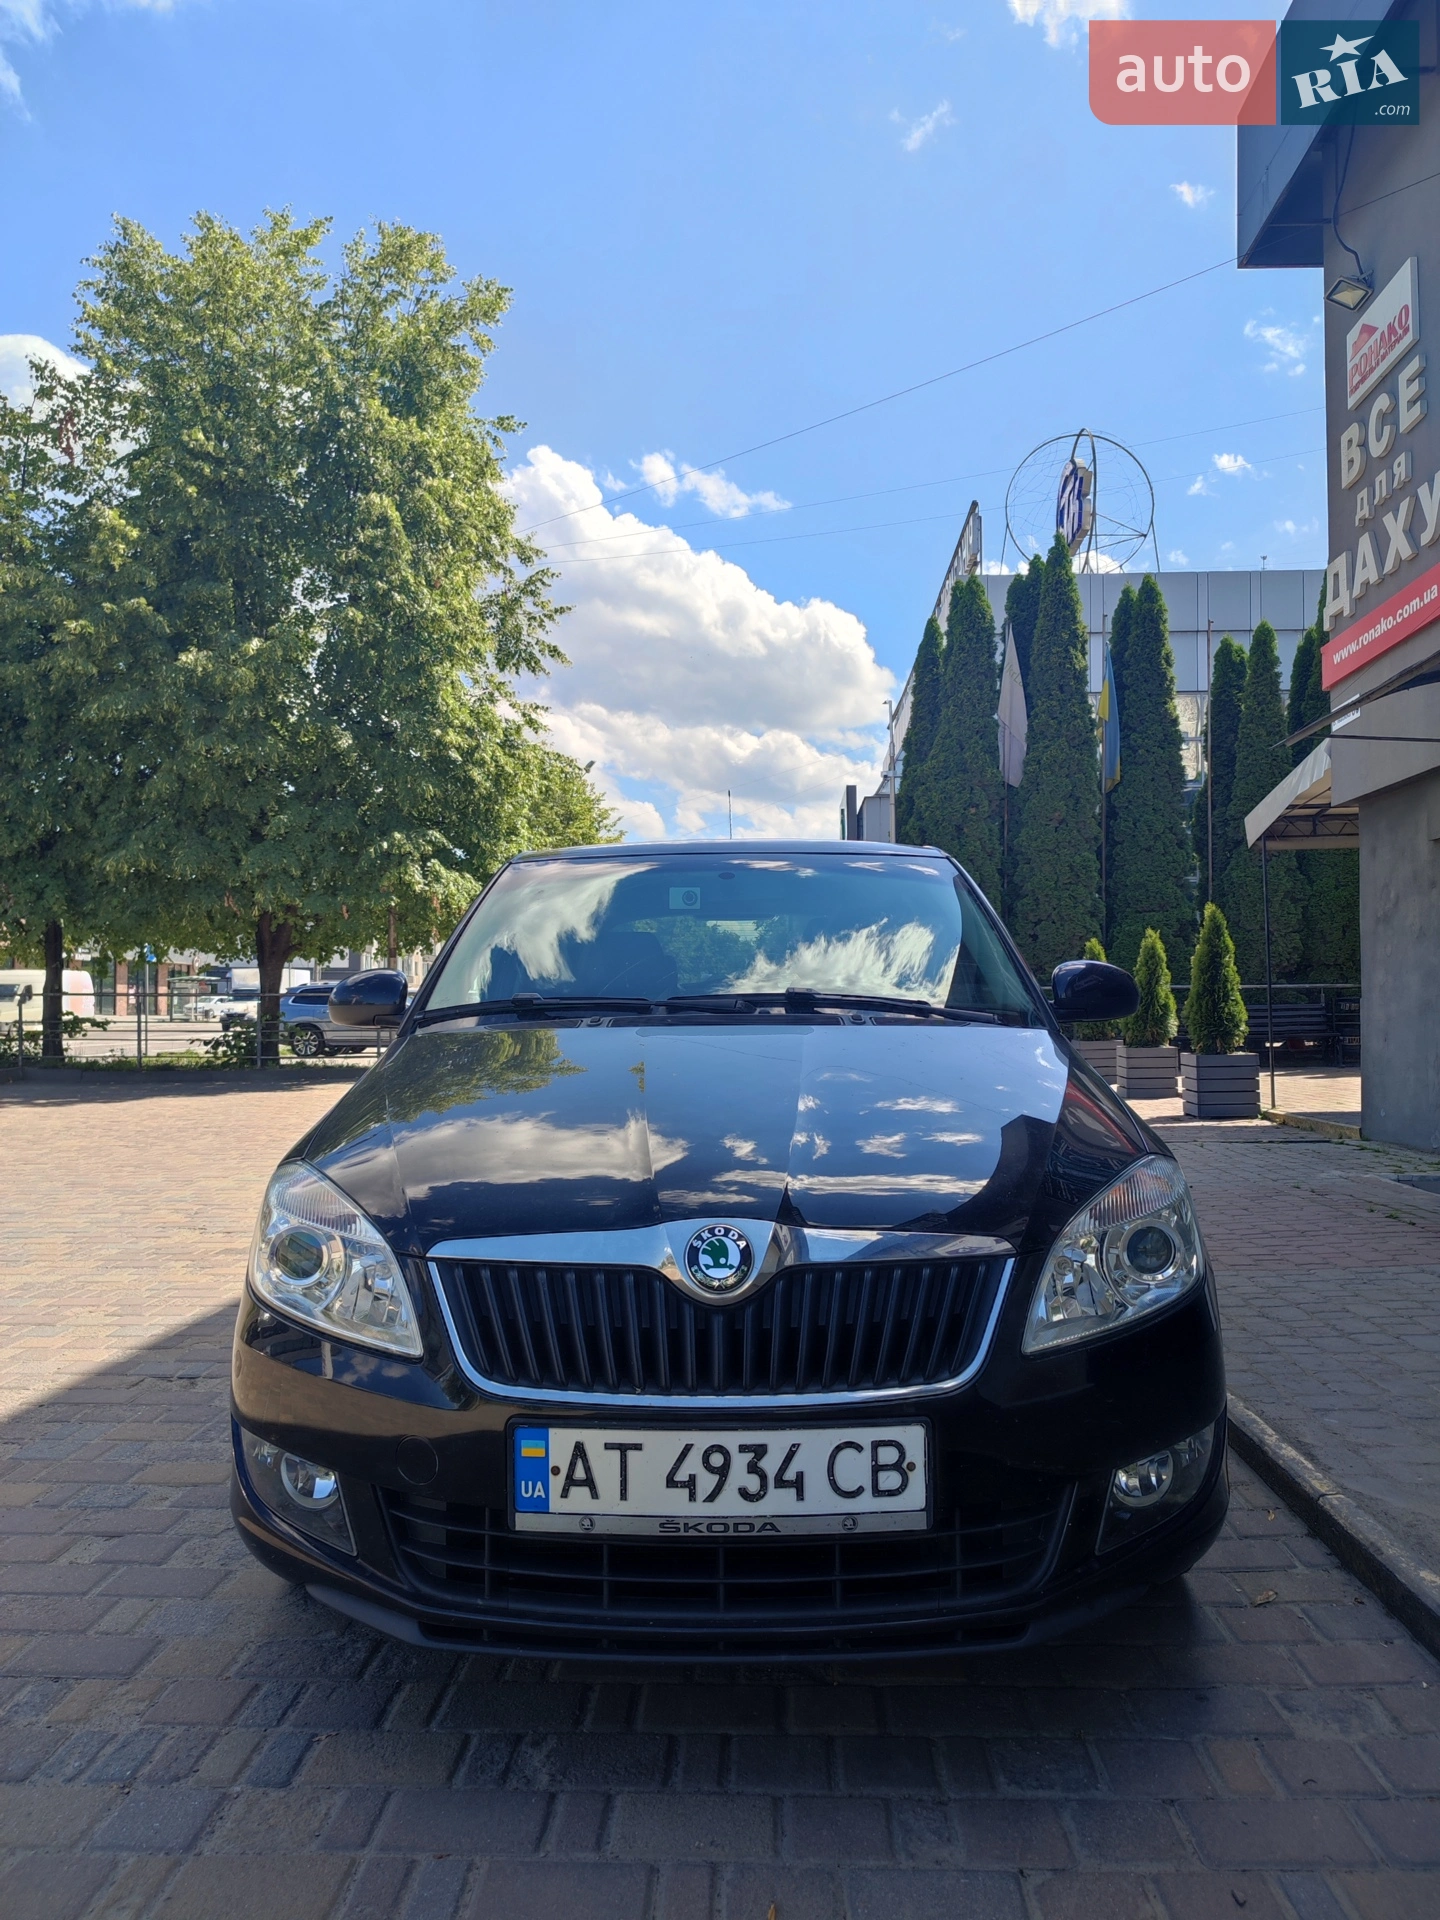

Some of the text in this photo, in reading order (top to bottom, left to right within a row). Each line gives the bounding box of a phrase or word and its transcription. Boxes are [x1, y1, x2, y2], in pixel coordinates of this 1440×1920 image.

[1348, 303, 1410, 388] РОНАКО
[1340, 354, 1427, 490] ВСЕ
[1323, 470, 1440, 631] ДАХУ
[1332, 584, 1439, 665] www.ronako.com.ua
[521, 1480, 546, 1499] UA
[560, 1439, 910, 1503] AT 4934 CB
[658, 1518, 782, 1534] ŠKODA
